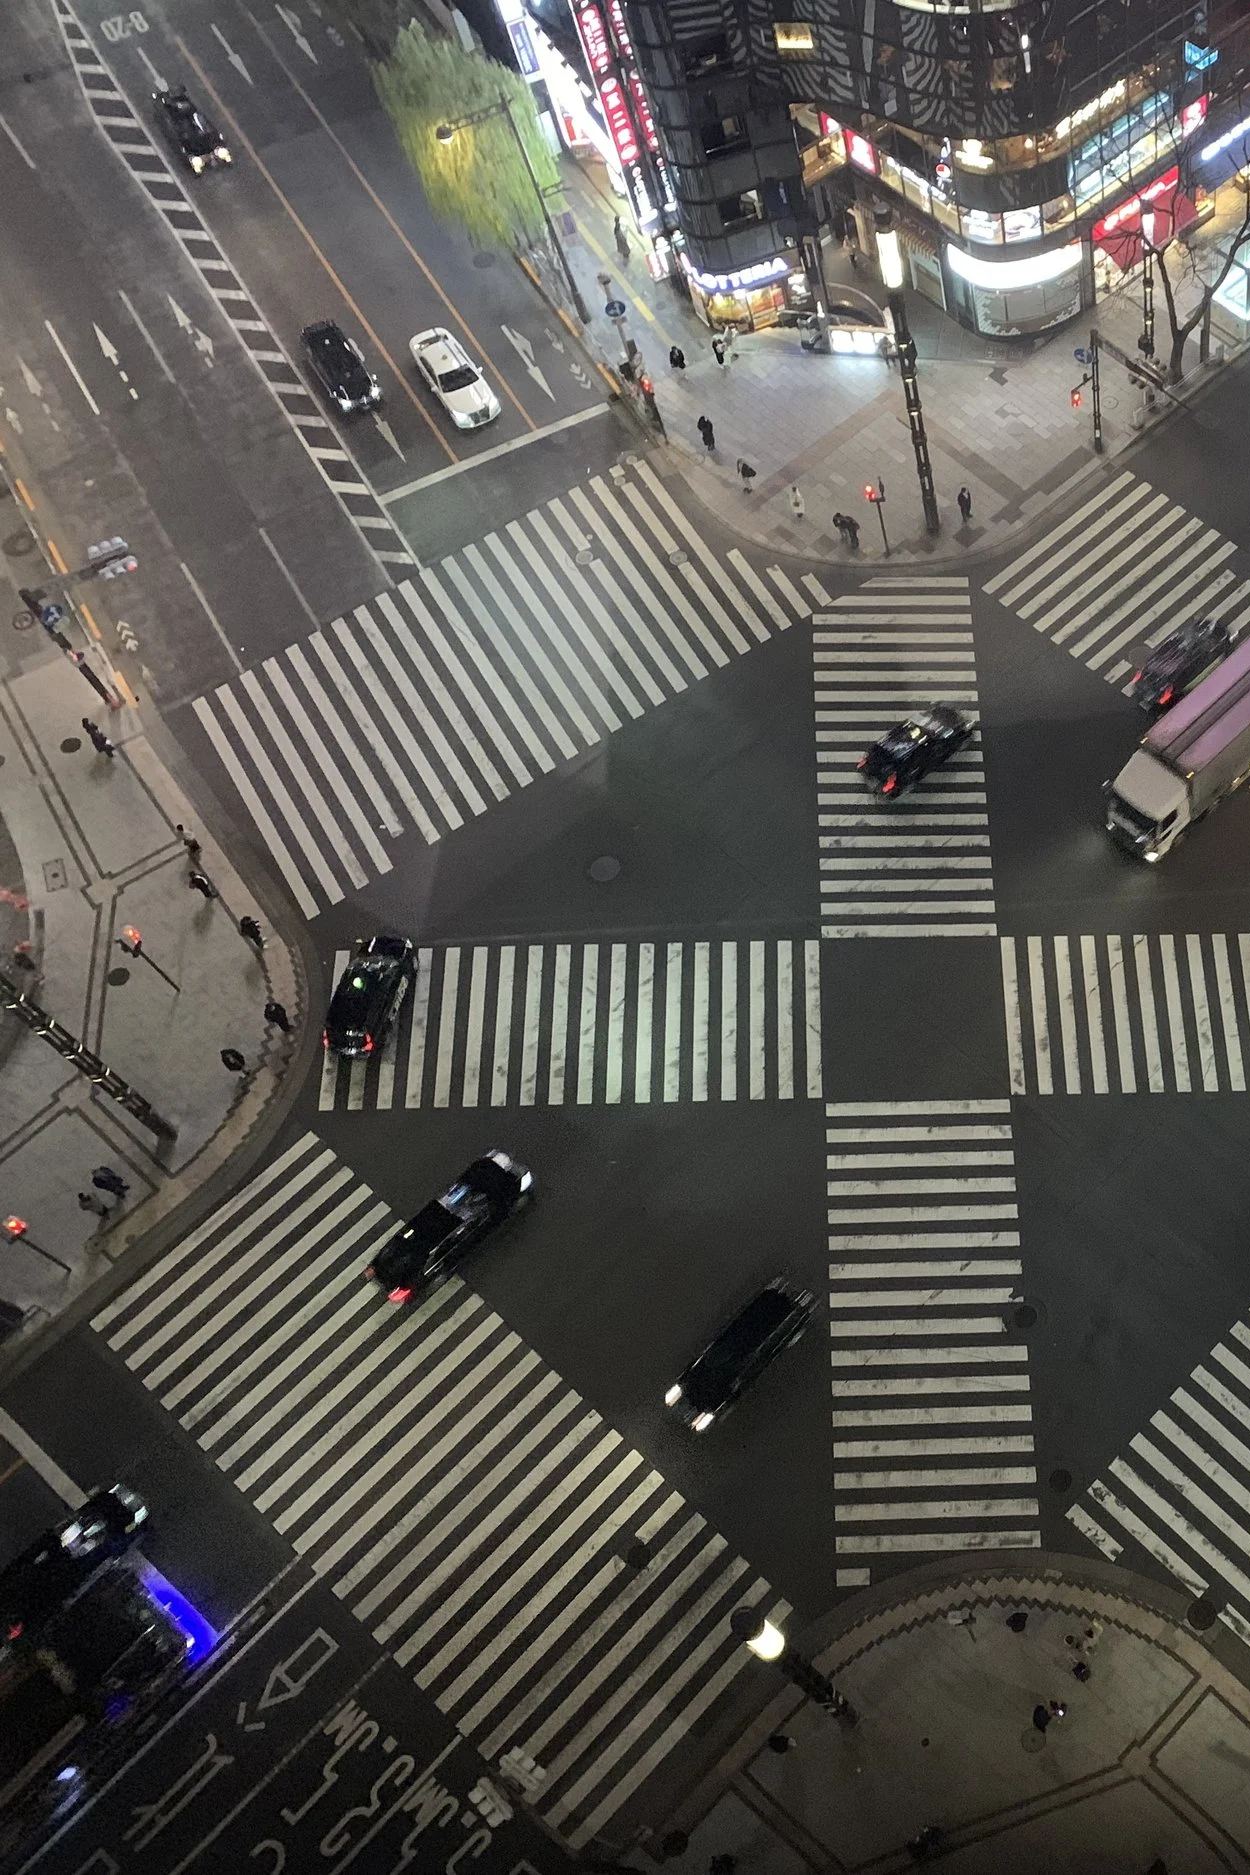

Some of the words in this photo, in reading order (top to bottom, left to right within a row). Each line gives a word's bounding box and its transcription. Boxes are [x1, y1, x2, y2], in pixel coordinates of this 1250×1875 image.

[100, 11, 150, 42] 8-20
[690, 256, 788, 290] LOTTERIA
[281, 1699, 416, 1858] 3.5M
